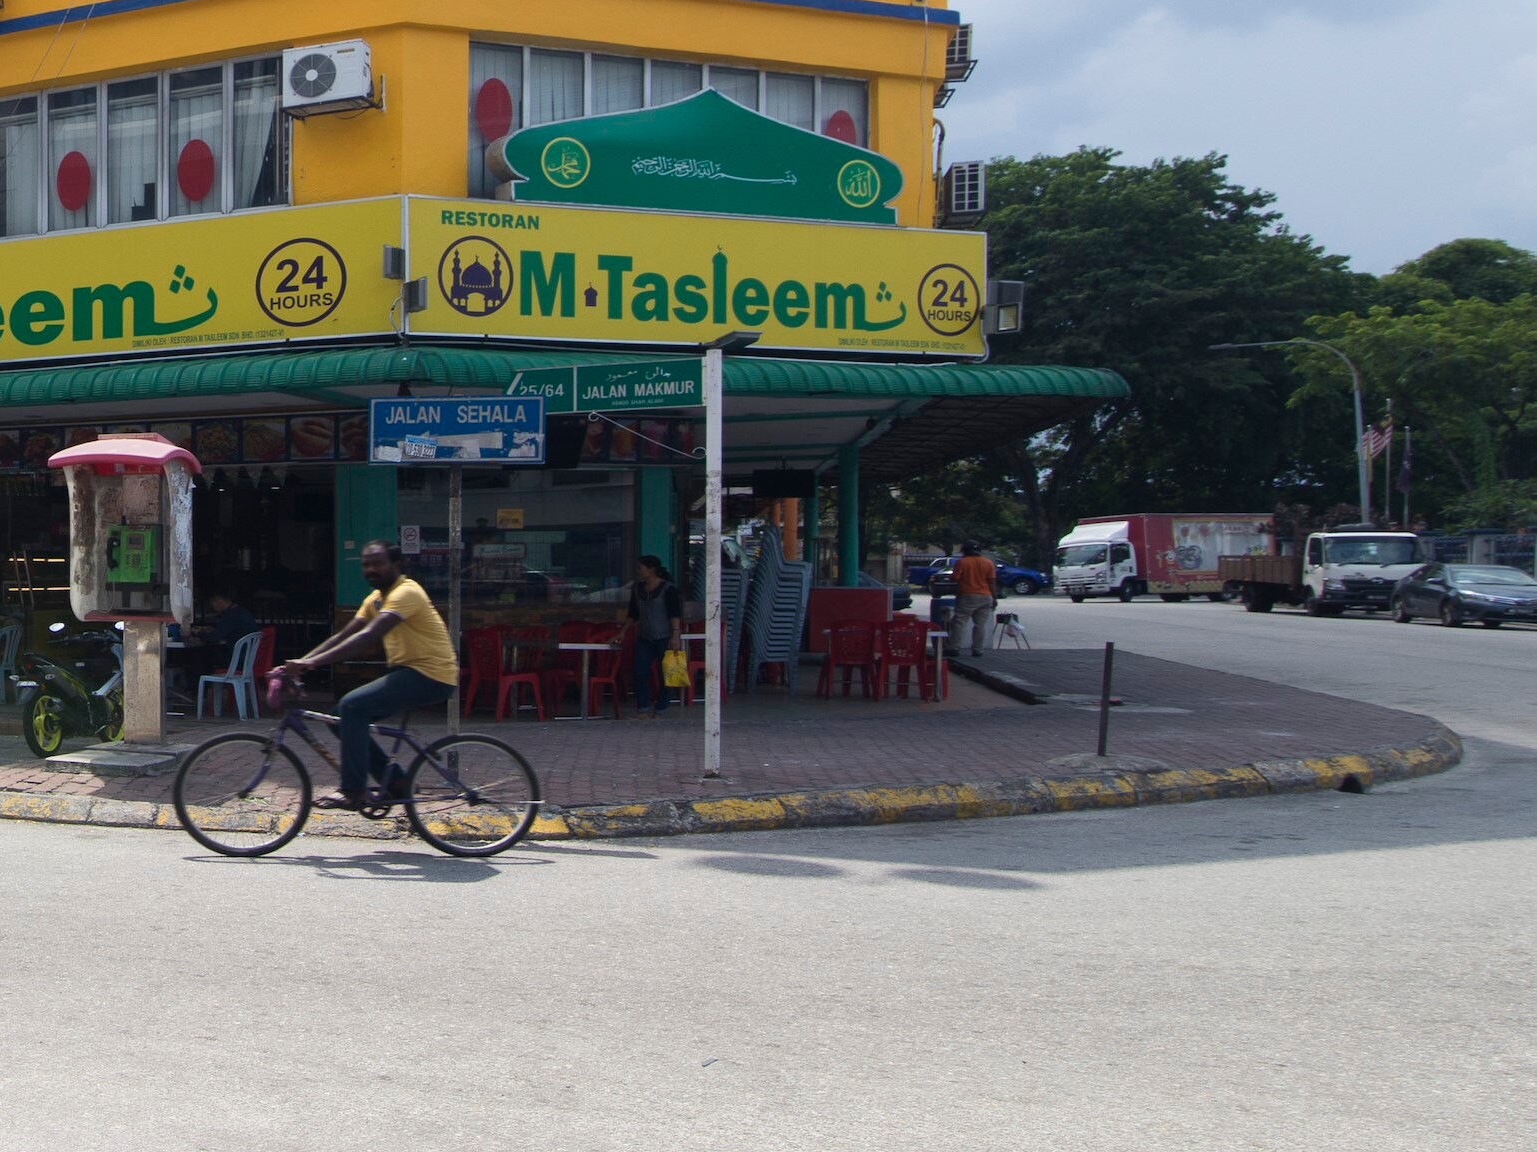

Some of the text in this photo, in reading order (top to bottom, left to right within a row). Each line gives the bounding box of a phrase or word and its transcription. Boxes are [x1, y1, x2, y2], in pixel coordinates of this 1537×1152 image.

[441, 209, 540, 230] RESTORAN
[275, 255, 328, 293] 24
[270, 292, 334, 310] HOURS
[931, 279, 967, 308] 24
[927, 309, 972, 322] HOURS
[170, 336, 198, 344] RESTORAN
[204, 334, 229, 343] TASLEEM
[582, 380, 695, 400] JALAN MAKMUR
[385, 404, 527, 425] JALAN SEHALA
